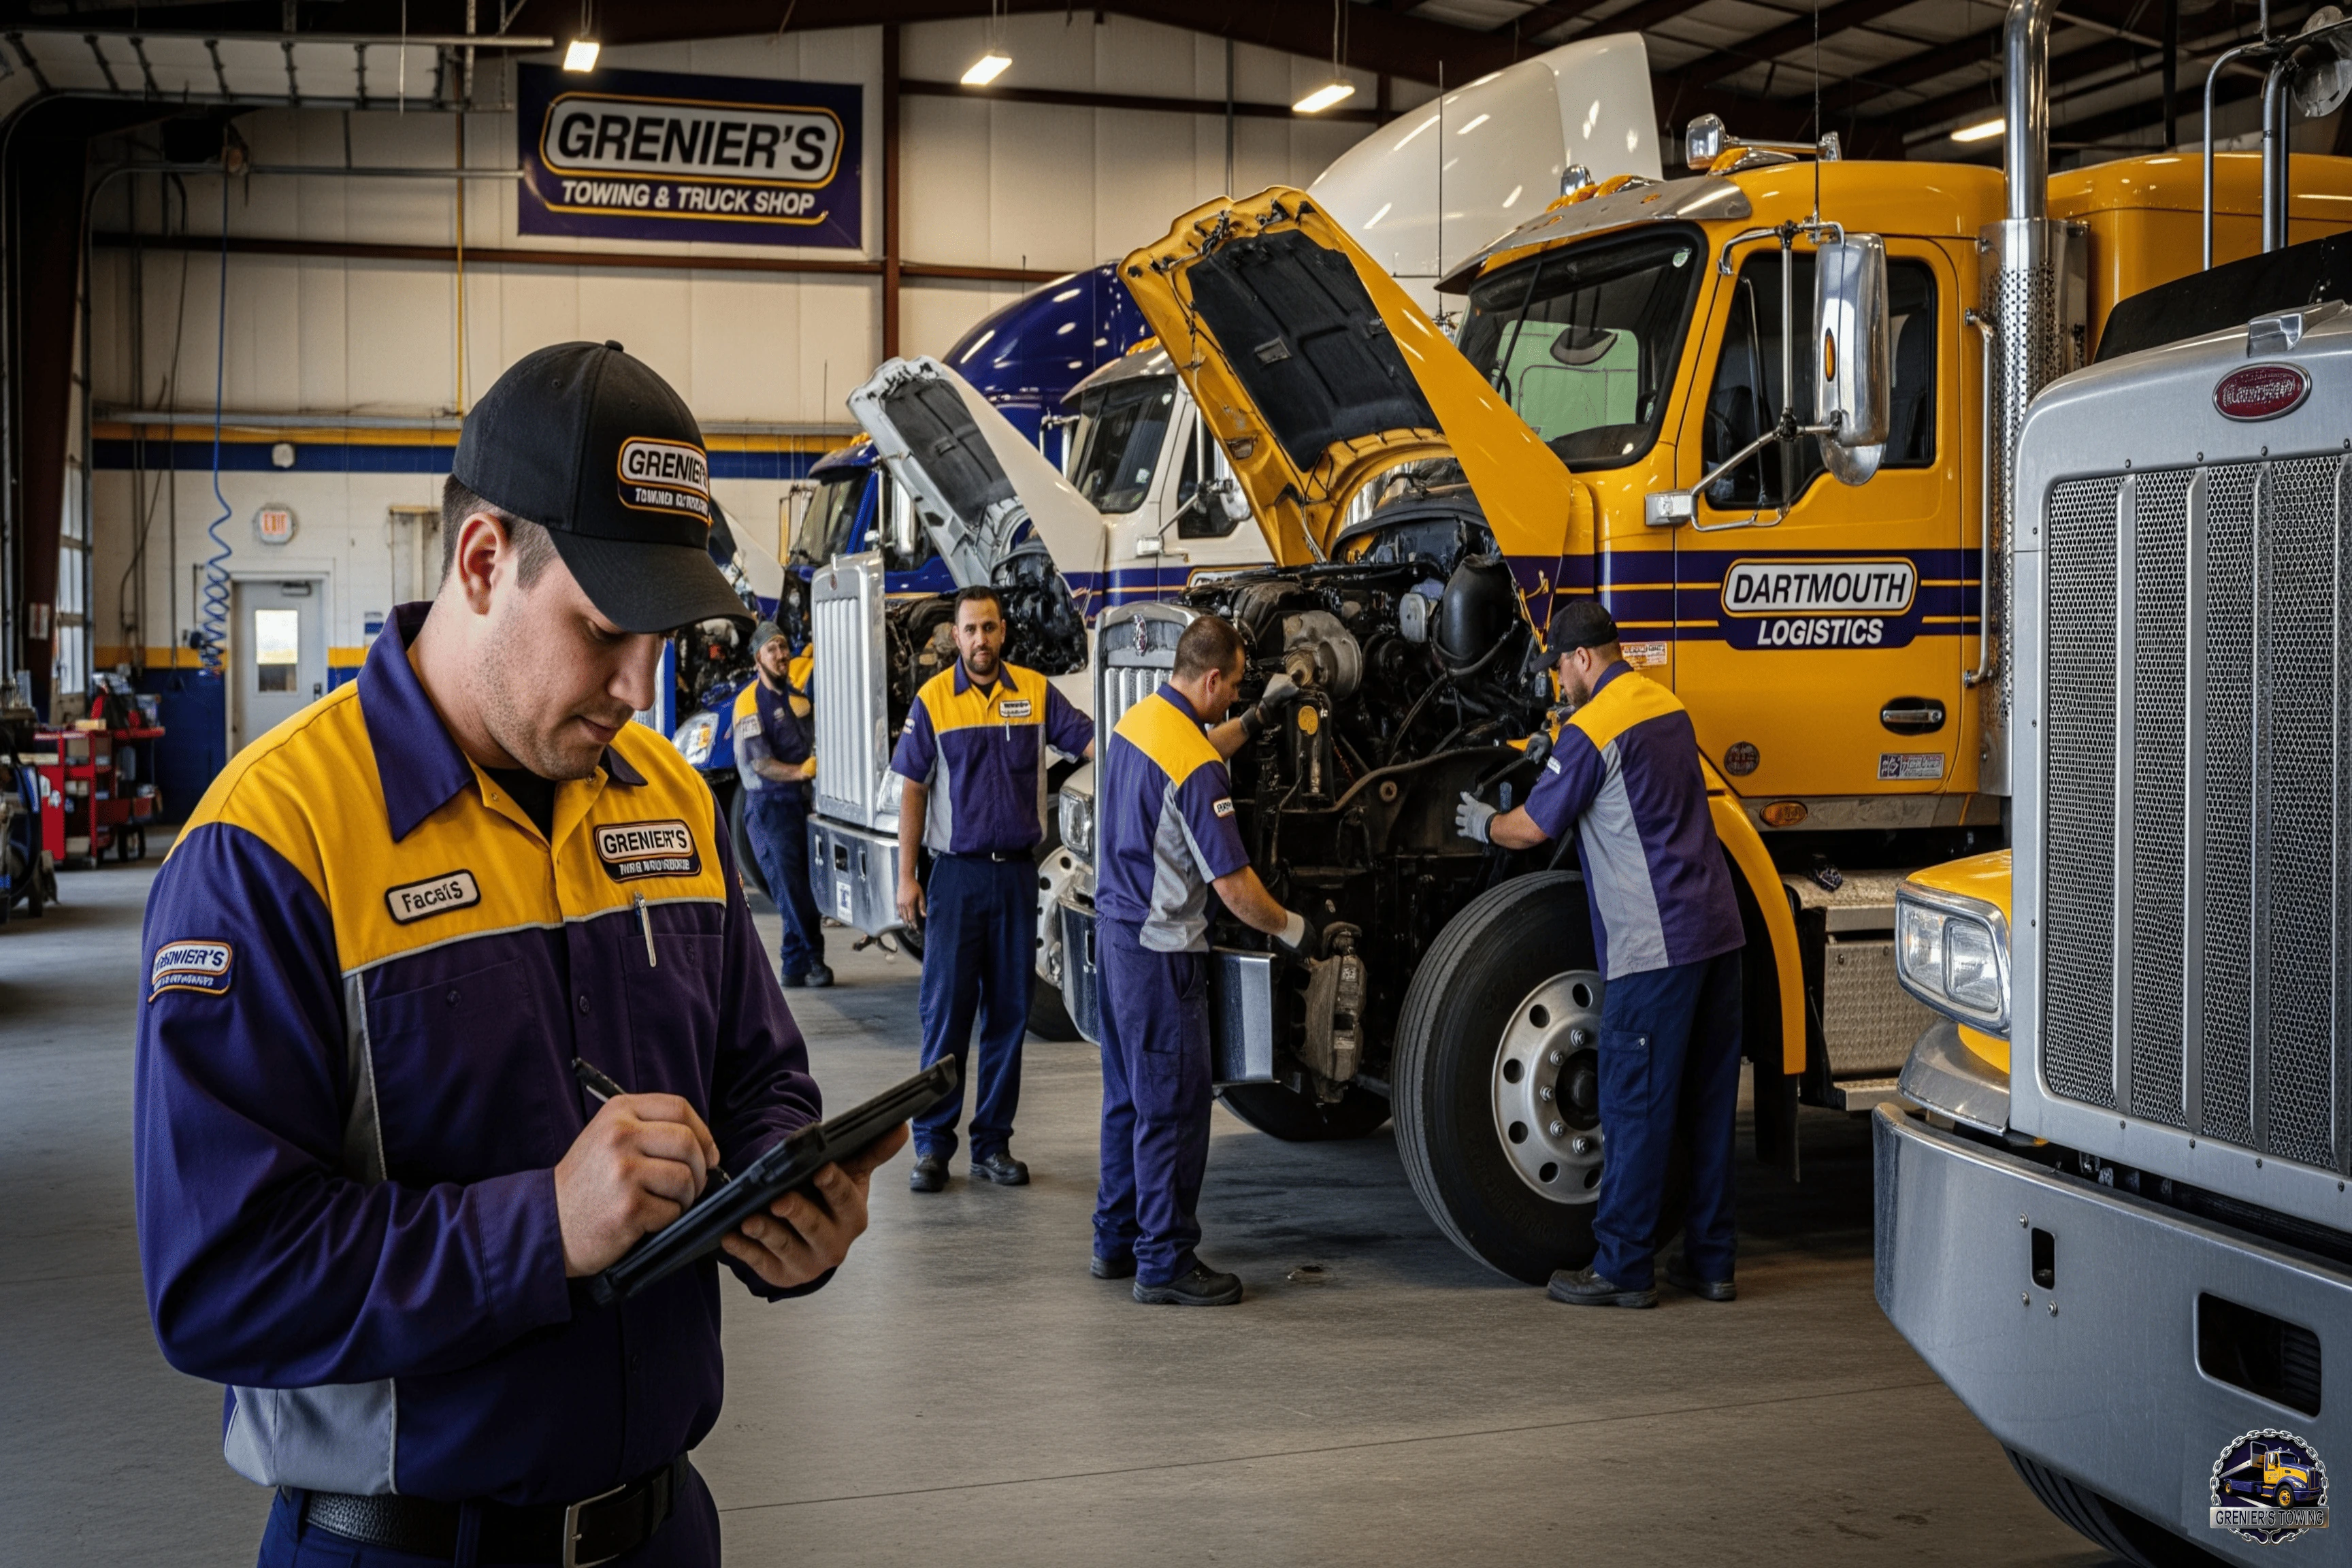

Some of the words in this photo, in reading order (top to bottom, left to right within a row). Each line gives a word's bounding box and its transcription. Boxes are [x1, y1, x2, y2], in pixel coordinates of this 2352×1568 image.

[558, 112, 827, 171] GRENIER'S
[562, 180, 649, 207] TOWING
[655, 186, 670, 208] &
[678, 186, 751, 212] TRUCK
[753, 191, 815, 215] SHOP
[1733, 572, 1907, 604] DARTMOUTH
[1757, 618, 1884, 646] LOGISTICS
